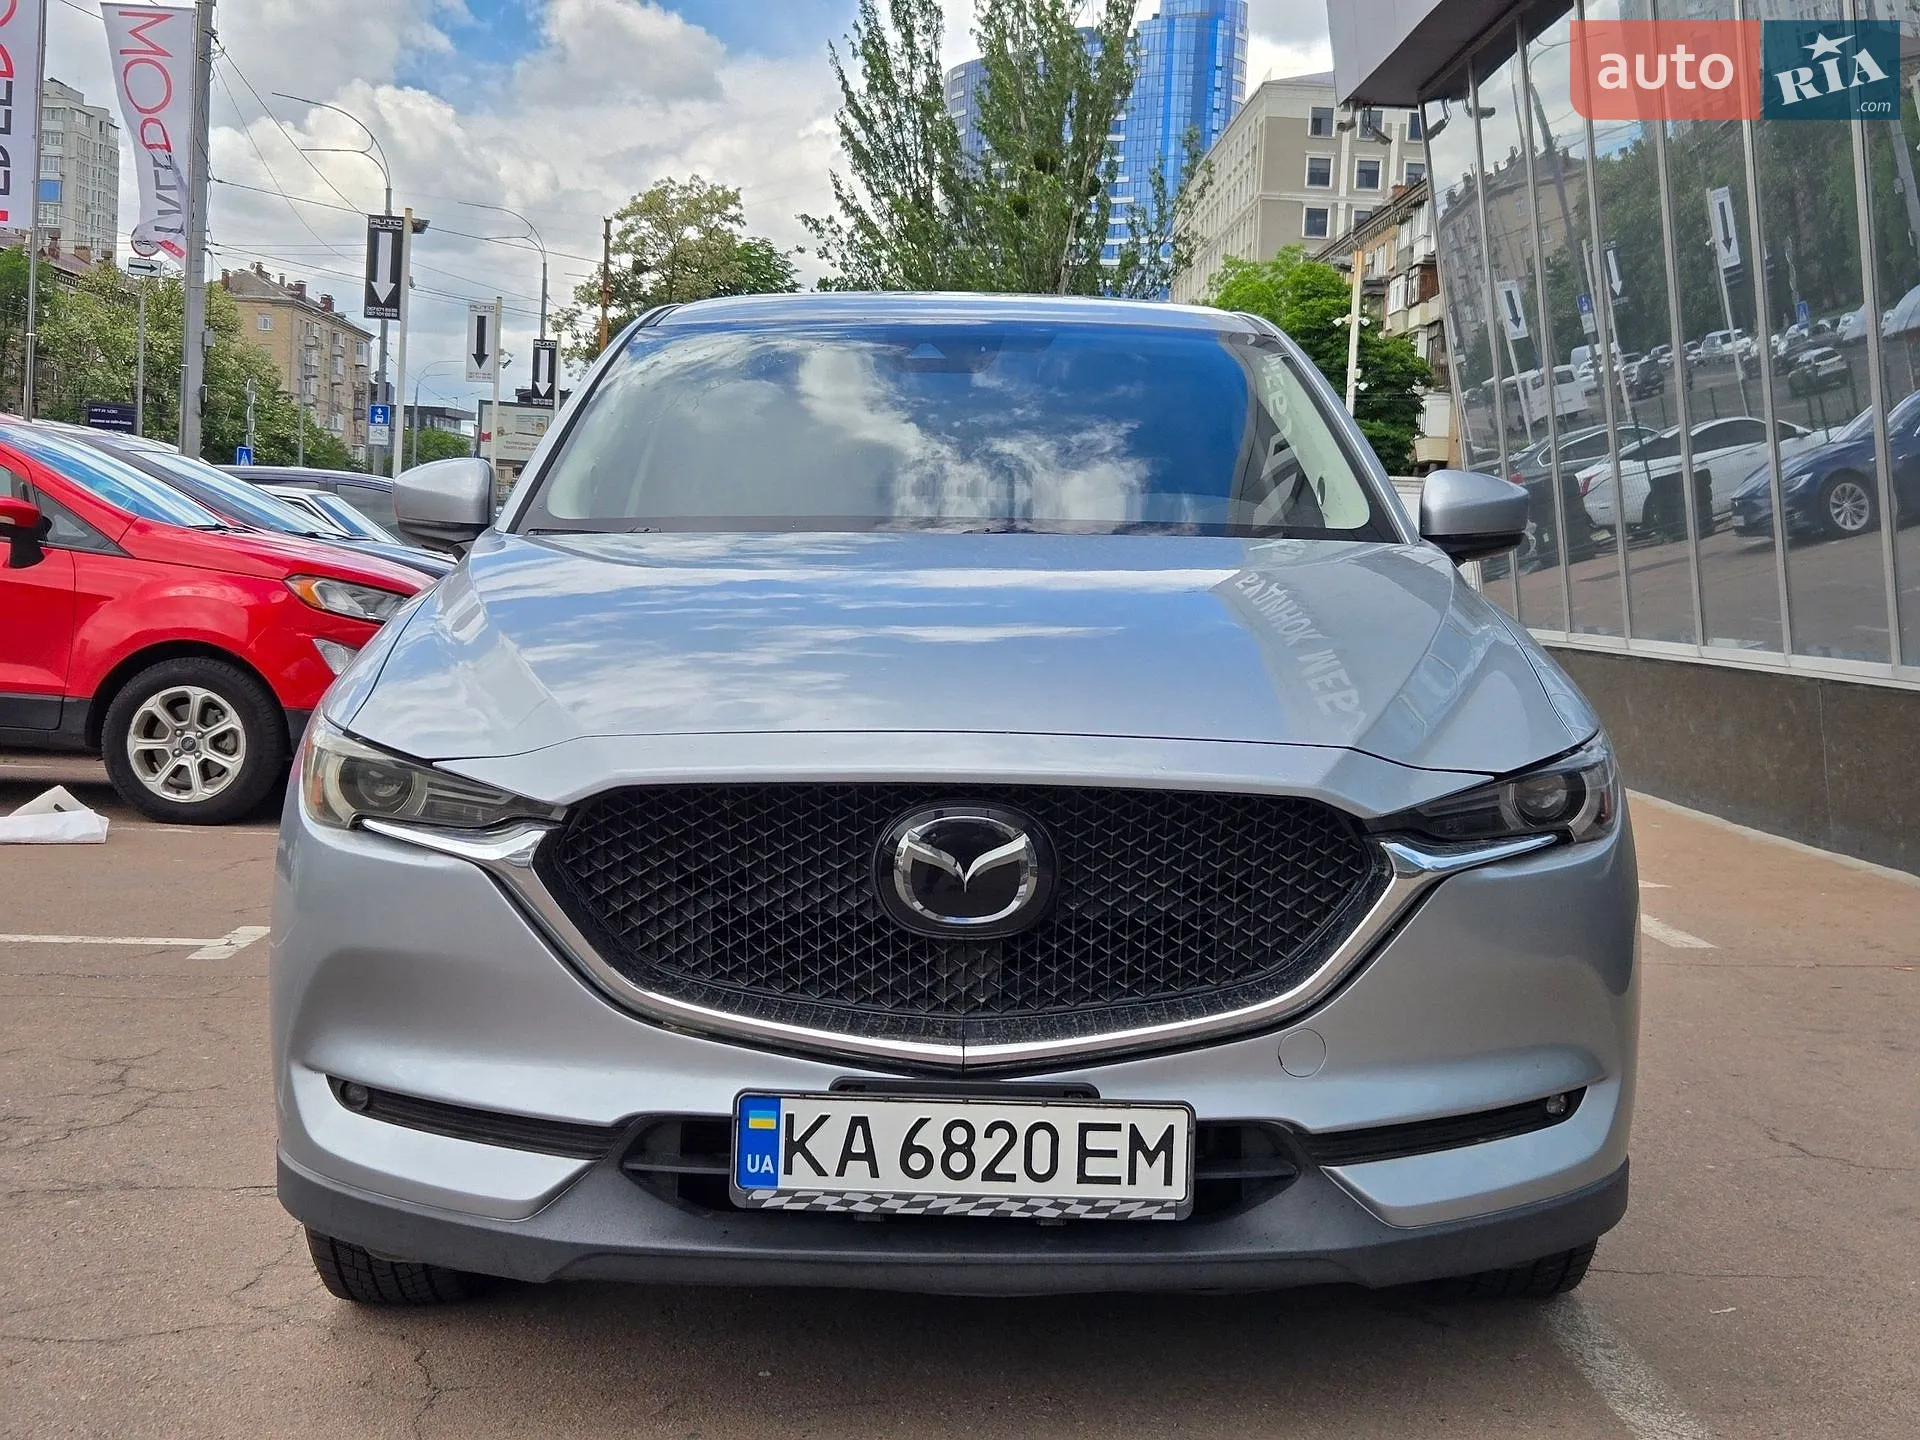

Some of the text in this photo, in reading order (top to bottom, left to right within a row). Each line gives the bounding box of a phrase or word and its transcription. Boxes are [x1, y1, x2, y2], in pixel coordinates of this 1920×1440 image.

[369, 217, 403, 226] AUTO
[783, 1112, 1176, 1187] KA 6820 EM
[746, 1153, 775, 1175] UA
